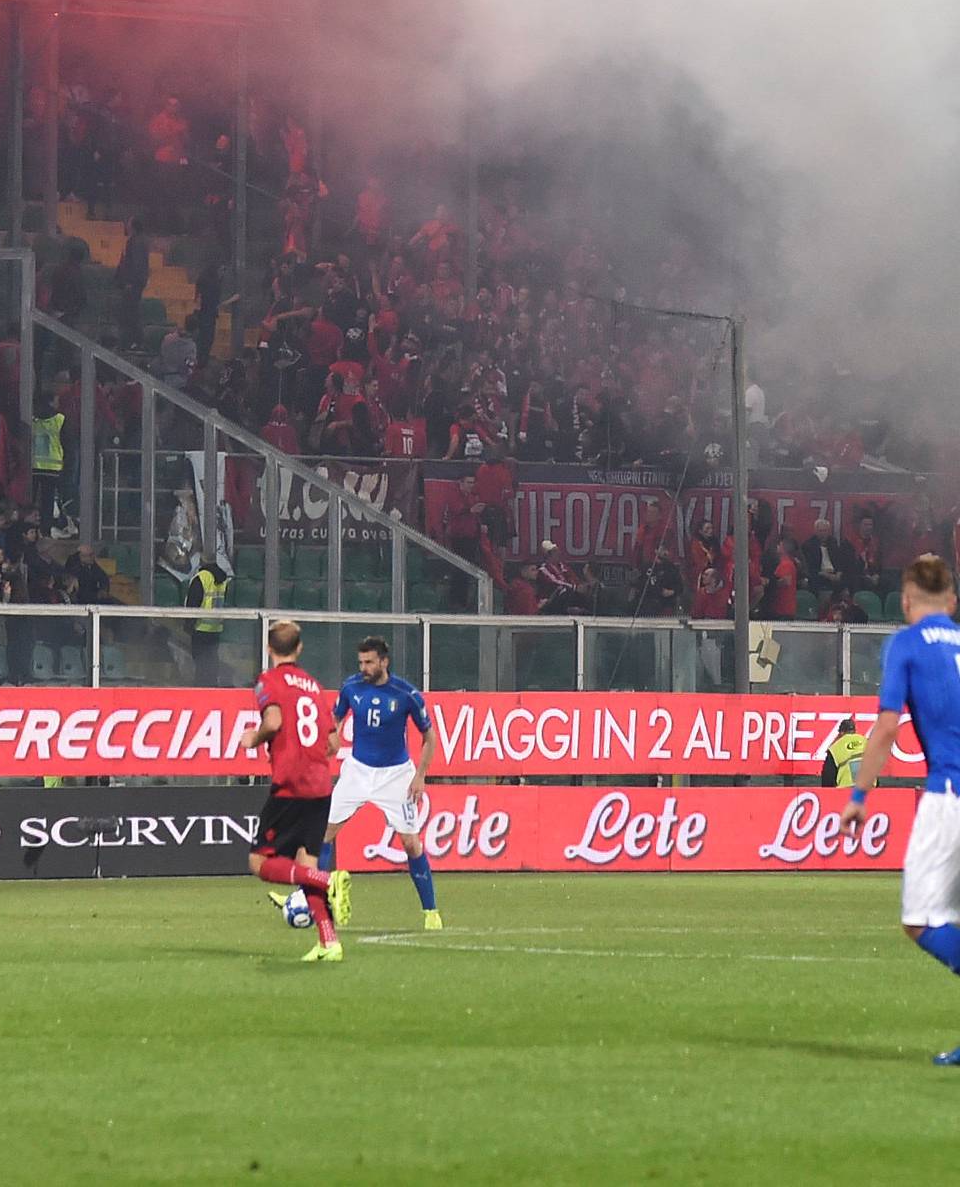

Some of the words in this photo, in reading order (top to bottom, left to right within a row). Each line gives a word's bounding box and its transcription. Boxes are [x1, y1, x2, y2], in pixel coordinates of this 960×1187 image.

[296, 696, 319, 748] 8
[366, 708, 381, 728] 15
[433, 704, 581, 765] VIAGGI
[592, 707, 637, 761] IN
[648, 707, 673, 760] 2
[682, 707, 732, 760] AL
[19, 815, 261, 847] SCRVIN
[401, 802, 415, 821] 15
[563, 791, 708, 864] Lete
